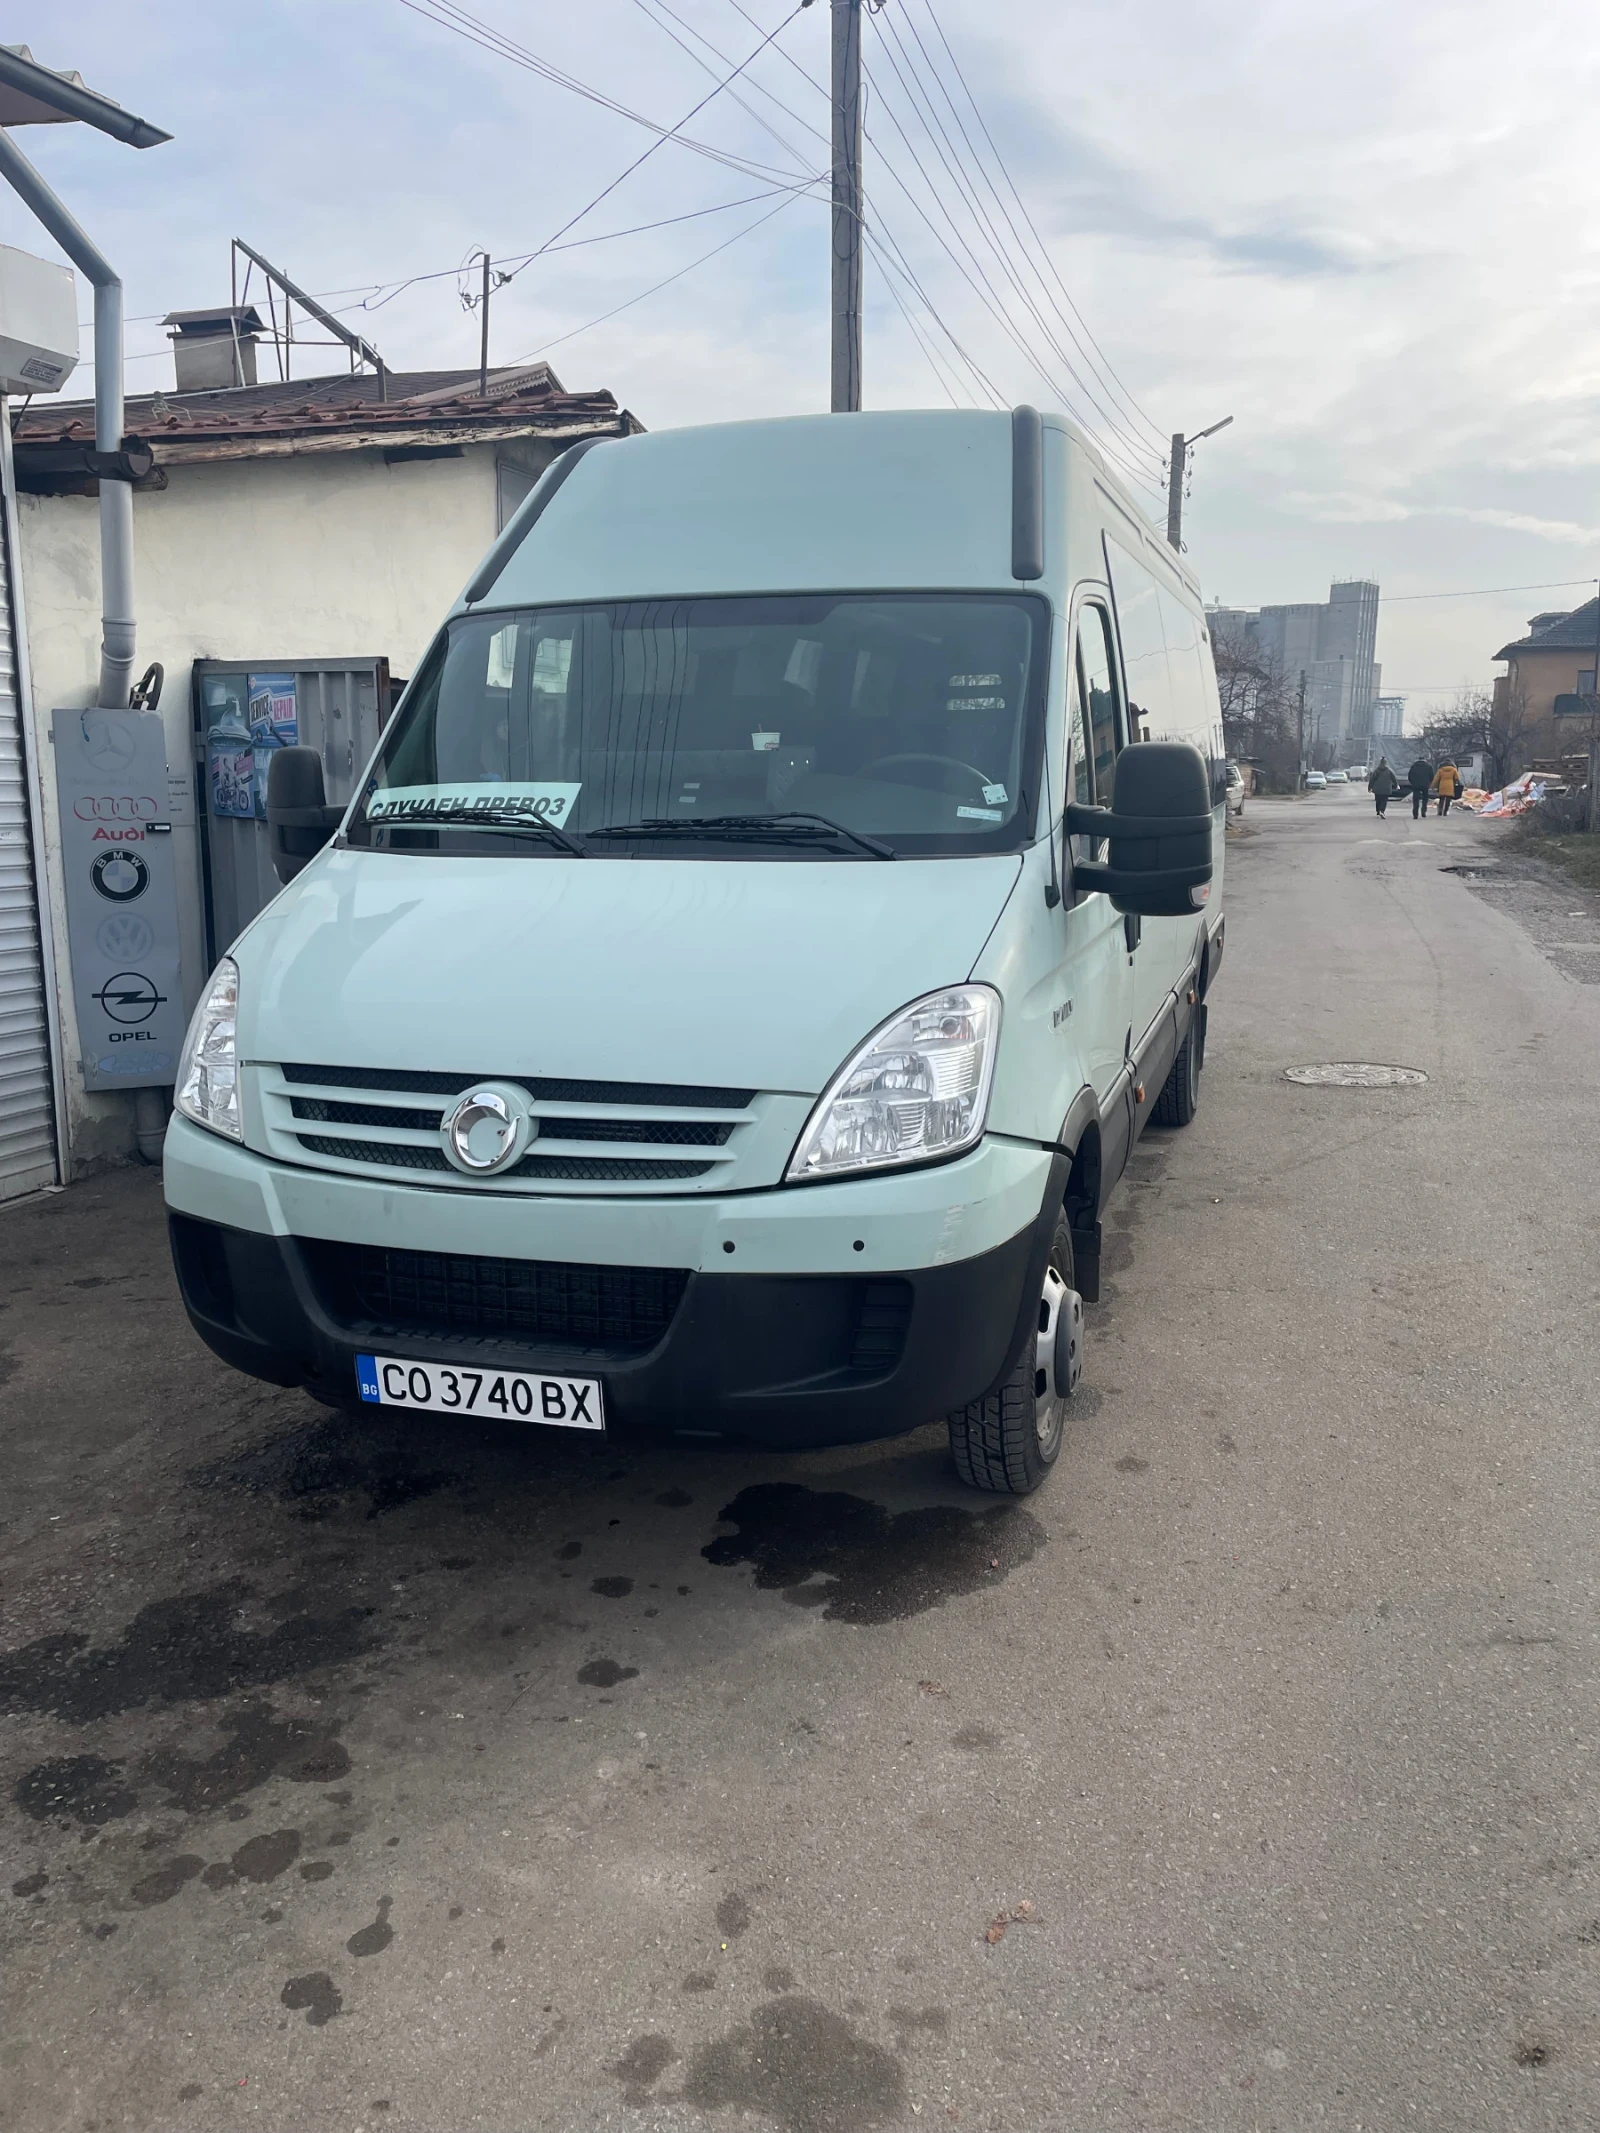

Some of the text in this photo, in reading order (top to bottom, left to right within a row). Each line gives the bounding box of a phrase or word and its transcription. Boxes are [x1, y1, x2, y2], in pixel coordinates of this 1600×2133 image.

[251, 694, 269, 722] SERVICE
[273, 698, 293, 721] REPAIR
[91, 826, 145, 841] Audi
[96, 851, 142, 869] BMW
[108, 1031, 157, 1043] OPEL
[362, 1383, 378, 1396] BG
